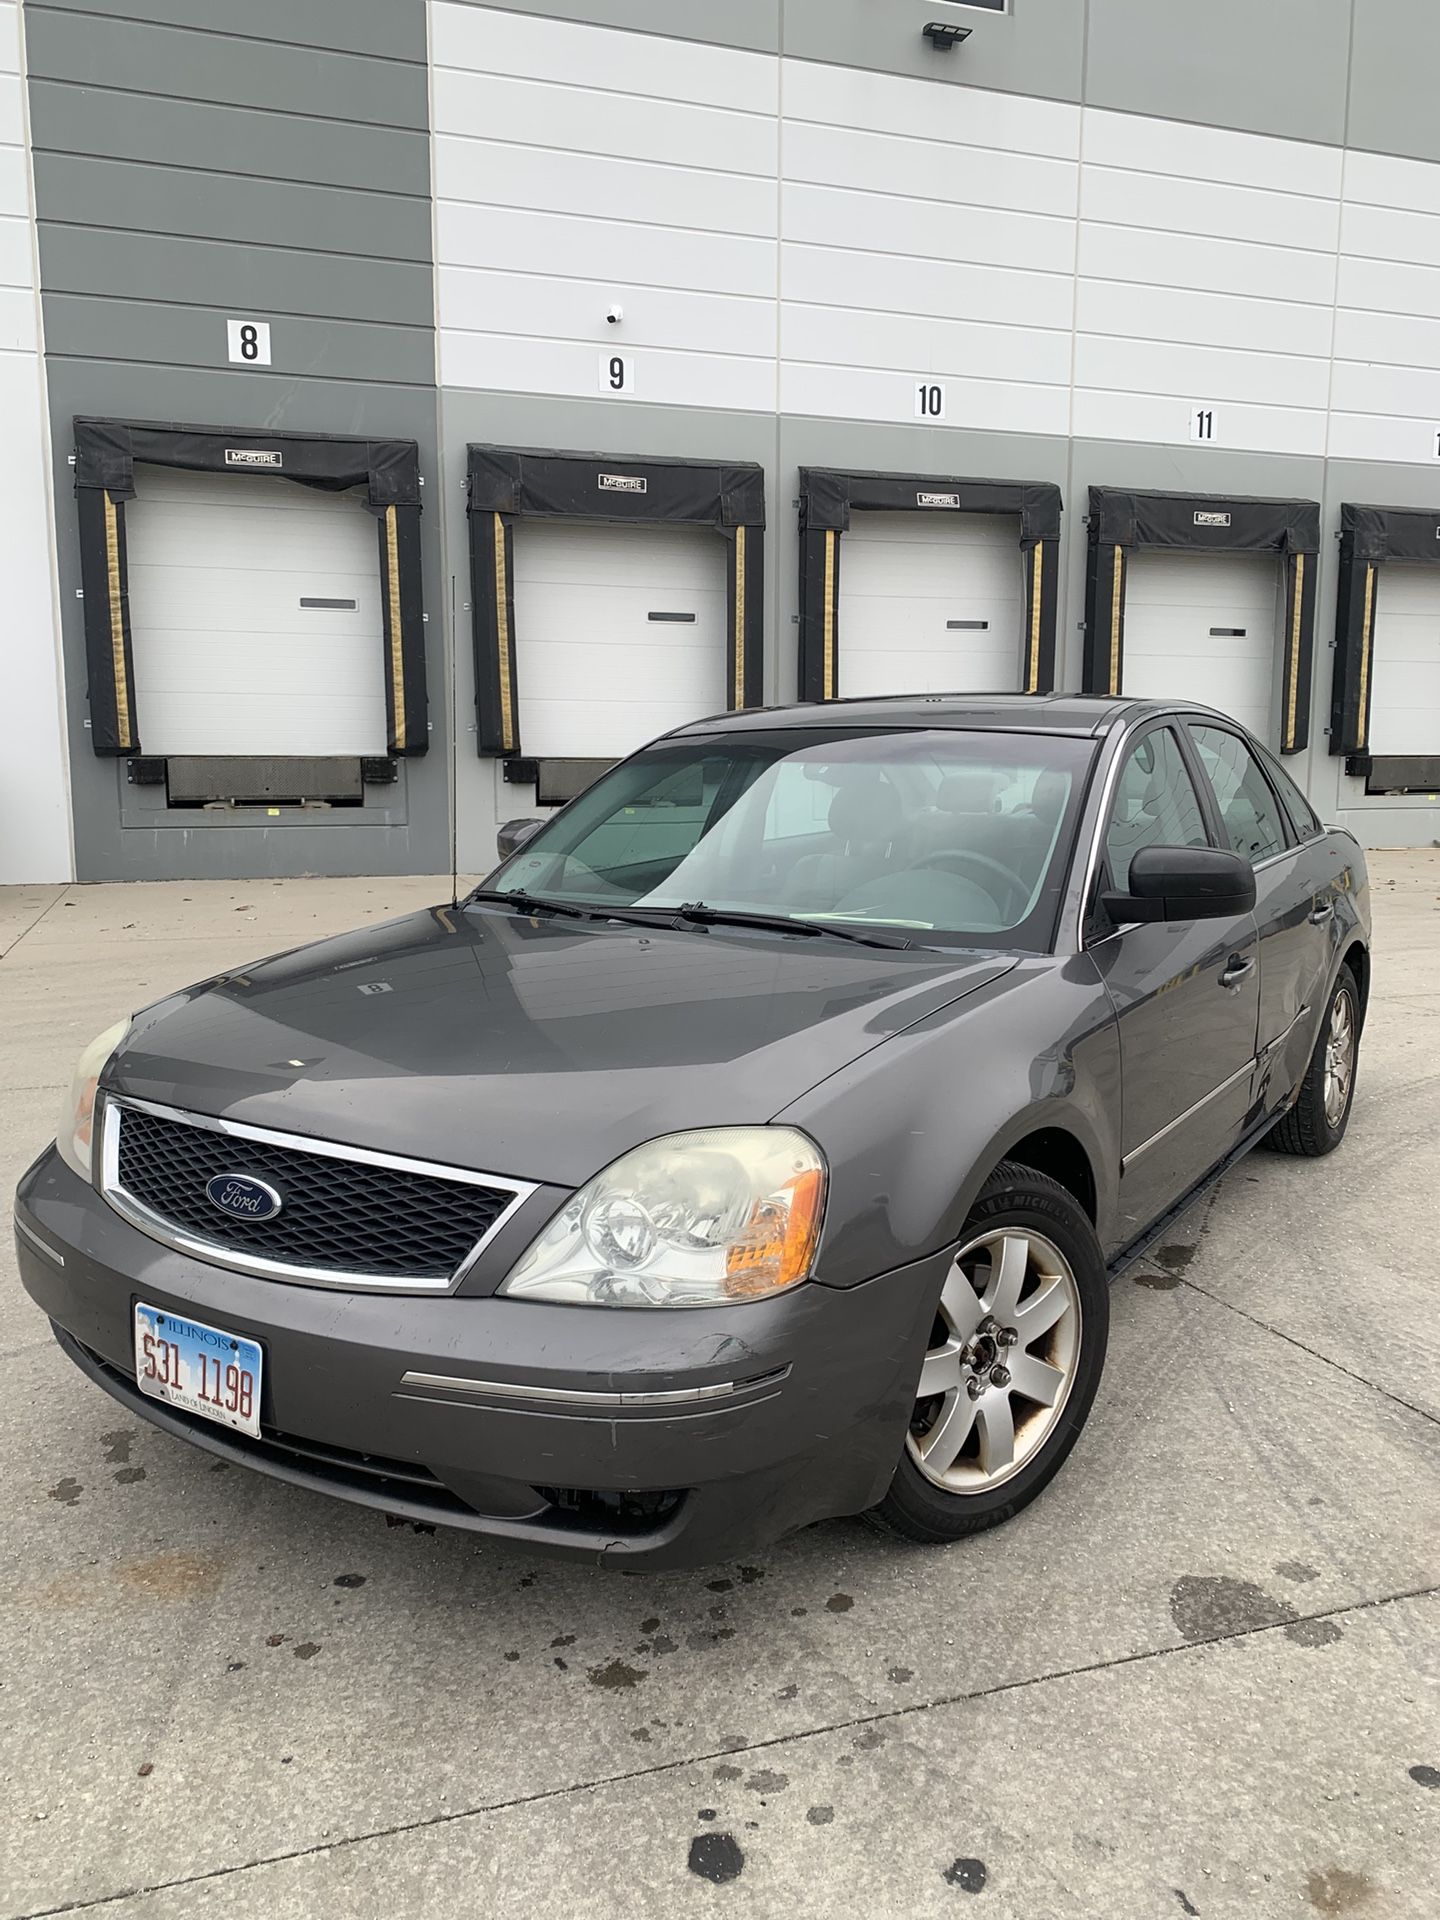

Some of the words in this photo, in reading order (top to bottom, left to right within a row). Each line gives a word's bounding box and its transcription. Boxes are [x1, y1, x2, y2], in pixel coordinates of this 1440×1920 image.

[240, 325, 258, 360] 8
[609, 357, 624, 390] 9
[918, 385, 942, 416] 10
[1197, 410, 1213, 439] 11
[221, 1181, 262, 1213] Ford
[168, 1320, 229, 1351] ILLINOIS
[143, 1333, 183, 1390] S31
[198, 1353, 253, 1418] 1198
